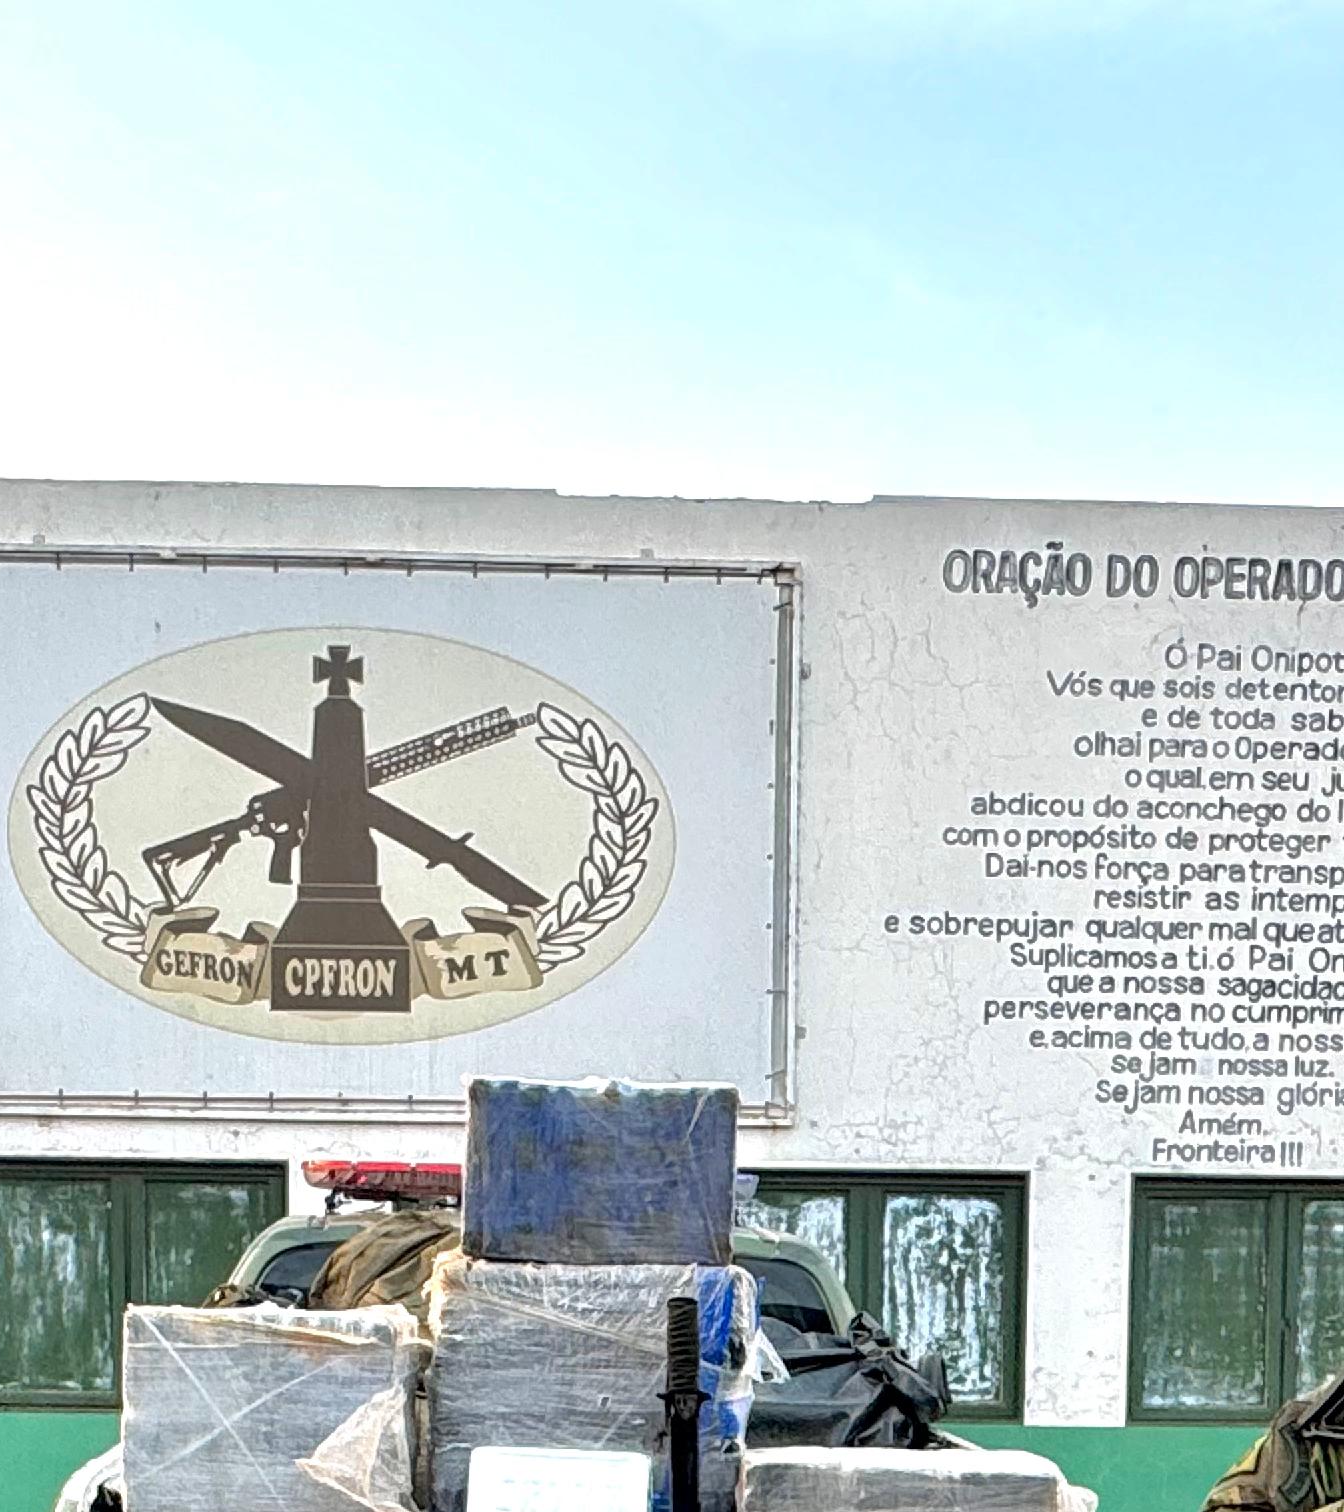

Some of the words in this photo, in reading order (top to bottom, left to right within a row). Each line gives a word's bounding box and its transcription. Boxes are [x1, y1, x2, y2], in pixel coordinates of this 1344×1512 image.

[943, 542, 1092, 608] ORAÇÃO
[1106, 554, 1160, 598] DO
[1196, 643, 1242, 671] Pai
[1046, 670, 1103, 697] Vós
[1110, 677, 1156, 702] que
[1162, 674, 1215, 700] sois
[1141, 708, 1158, 728] e
[1167, 706, 1201, 729] de
[1210, 706, 1276, 731] toda
[1149, 737, 1207, 763] para
[1213, 741, 1230, 759] o
[1124, 768, 1142, 788] o
[1208, 770, 1255, 791] em
[1261, 771, 1310, 792] seu
[970, 792, 1084, 817] abdicou
[1093, 795, 1130, 819] do
[1136, 796, 1288, 828] aconchego
[1296, 798, 1331, 823] do
[942, 826, 999, 847] com
[1004, 829, 1022, 848] o
[1026, 824, 1157, 853] propósito
[1165, 827, 1199, 851] de
[1209, 828, 1332, 860] proteger
[985, 853, 1088, 880] Dai-nos
[1094, 853, 1170, 886] força
[1179, 862, 1246, 886] para
[1094, 885, 1191, 911] resistir
[1204, 890, 1240, 910] as
[884, 914, 899, 934] e
[908, 911, 1073, 947] sobrepujar
[1085, 916, 1203, 945] qualquer
[1208, 917, 1257, 941] mal
[1262, 921, 1316, 948] que
[157, 949, 255, 991] GEFRON
[1010, 942, 1157, 973] Suplicamos
[1161, 949, 1178, 969] a
[1248, 945, 1294, 972] Pai
[283, 956, 399, 999] CPFRON
[1047, 974, 1093, 998] que
[1098, 975, 1116, 995] a
[1123, 975, 1205, 996] nossa
[983, 998, 1182, 1025] perseverança
[1190, 1002, 1226, 1023] no
[1051, 1025, 1132, 1050] acima
[1139, 1026, 1172, 1051] de
[1252, 1032, 1269, 1052] a
[1218, 1057, 1288, 1078] nossa
[1293, 1055, 1336, 1079] luz.
[1187, 1084, 1265, 1106] nossa
